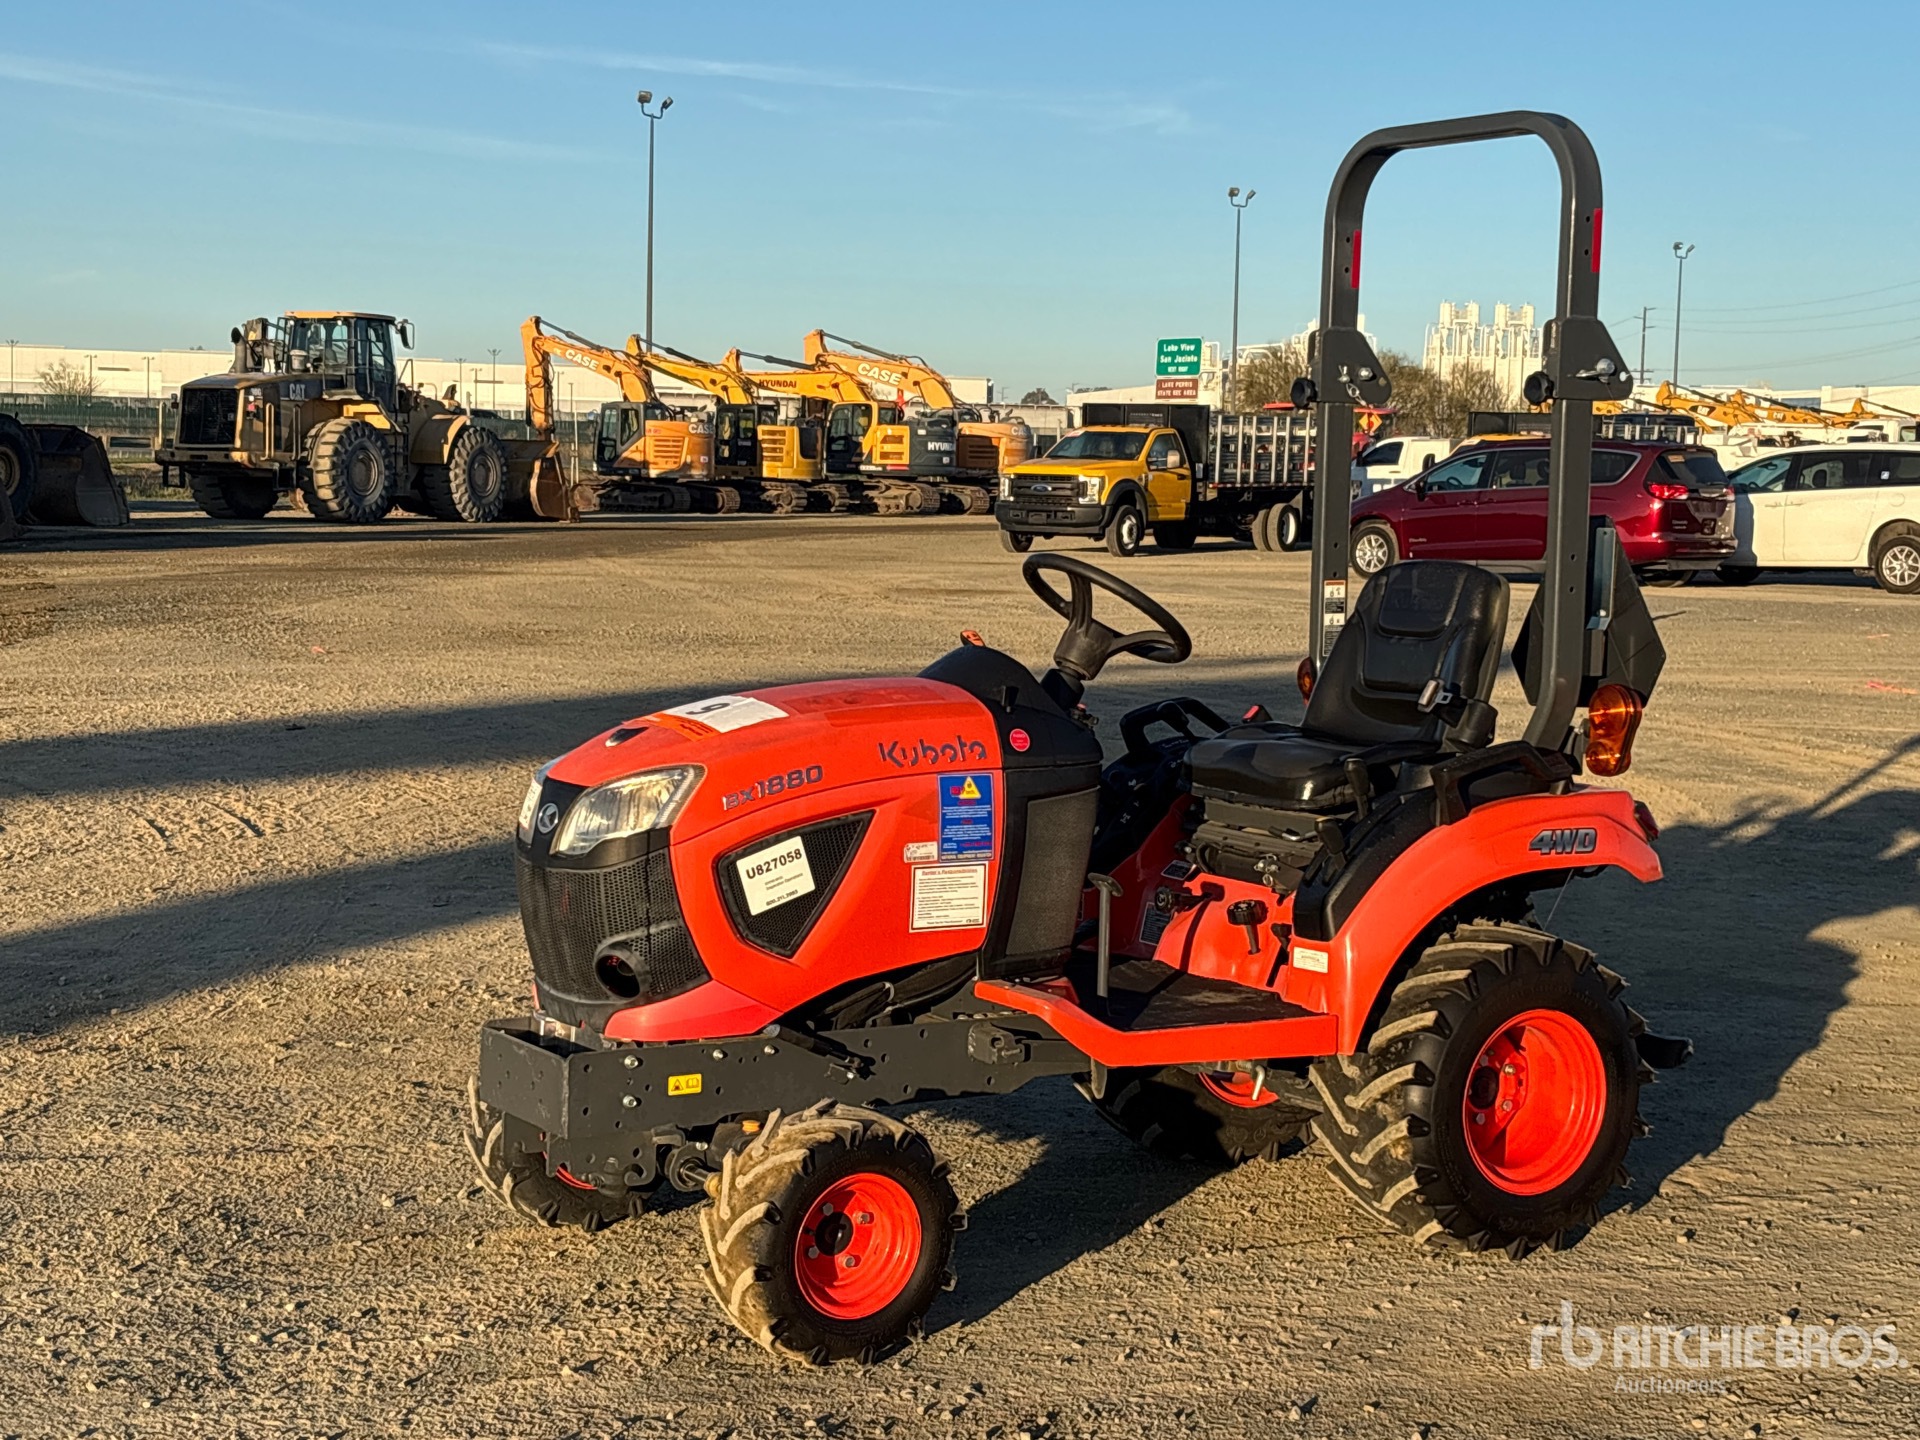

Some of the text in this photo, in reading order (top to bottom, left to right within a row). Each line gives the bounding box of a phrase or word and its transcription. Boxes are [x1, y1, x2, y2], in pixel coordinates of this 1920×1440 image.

[564, 349, 600, 371] CASE
[1160, 354, 1198, 363] San Jacinto
[758, 378, 797, 389] HYUNDAI
[857, 362, 902, 386] CASE
[289, 383, 306, 400] CAT
[877, 734, 988, 768] Kubota
[722, 764, 823, 811] BX1880
[1528, 826, 1598, 855] 4WD
[745, 848, 803, 880] U827058
